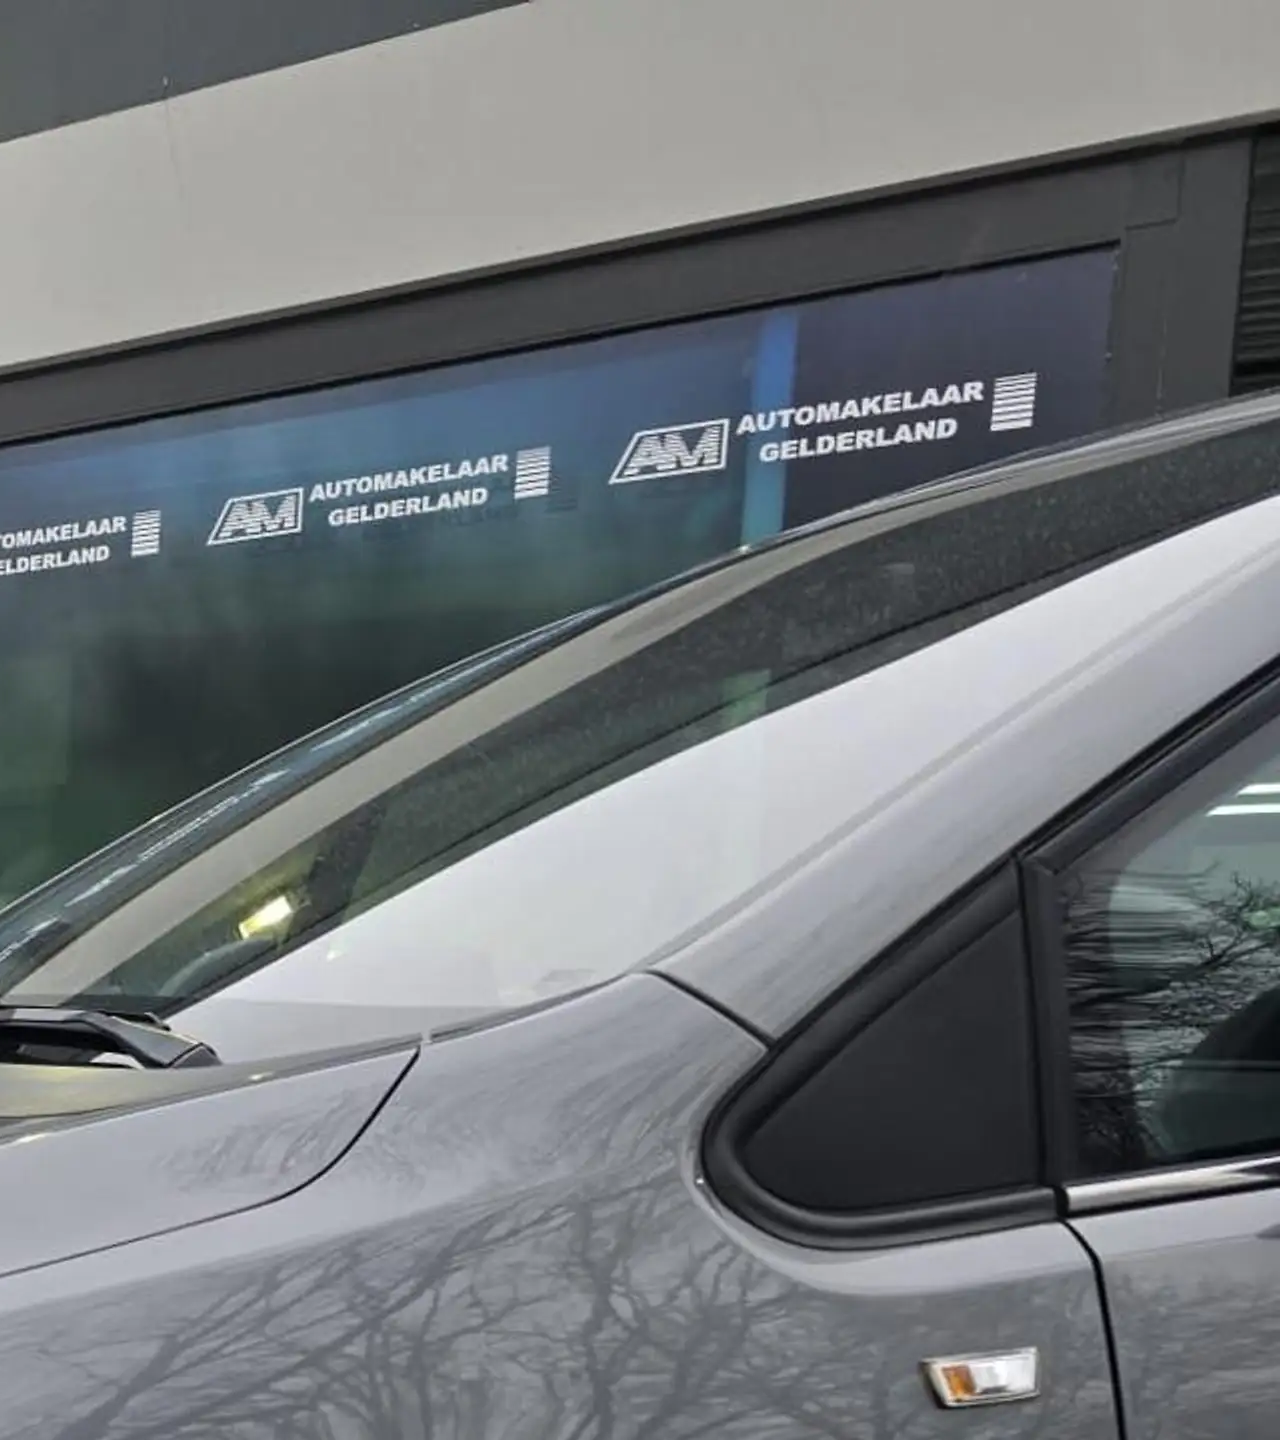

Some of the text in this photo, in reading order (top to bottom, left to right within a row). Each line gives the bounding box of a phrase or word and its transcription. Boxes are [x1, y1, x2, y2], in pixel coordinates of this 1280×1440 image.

[737, 380, 984, 435] AUTOMAKELAAR
[622, 422, 724, 479] AM
[759, 418, 958, 463] GELDERLAND
[309, 455, 509, 502] AUTOMAKELAAR
[218, 492, 298, 539] AM
[328, 488, 489, 527] GELDERLAND
